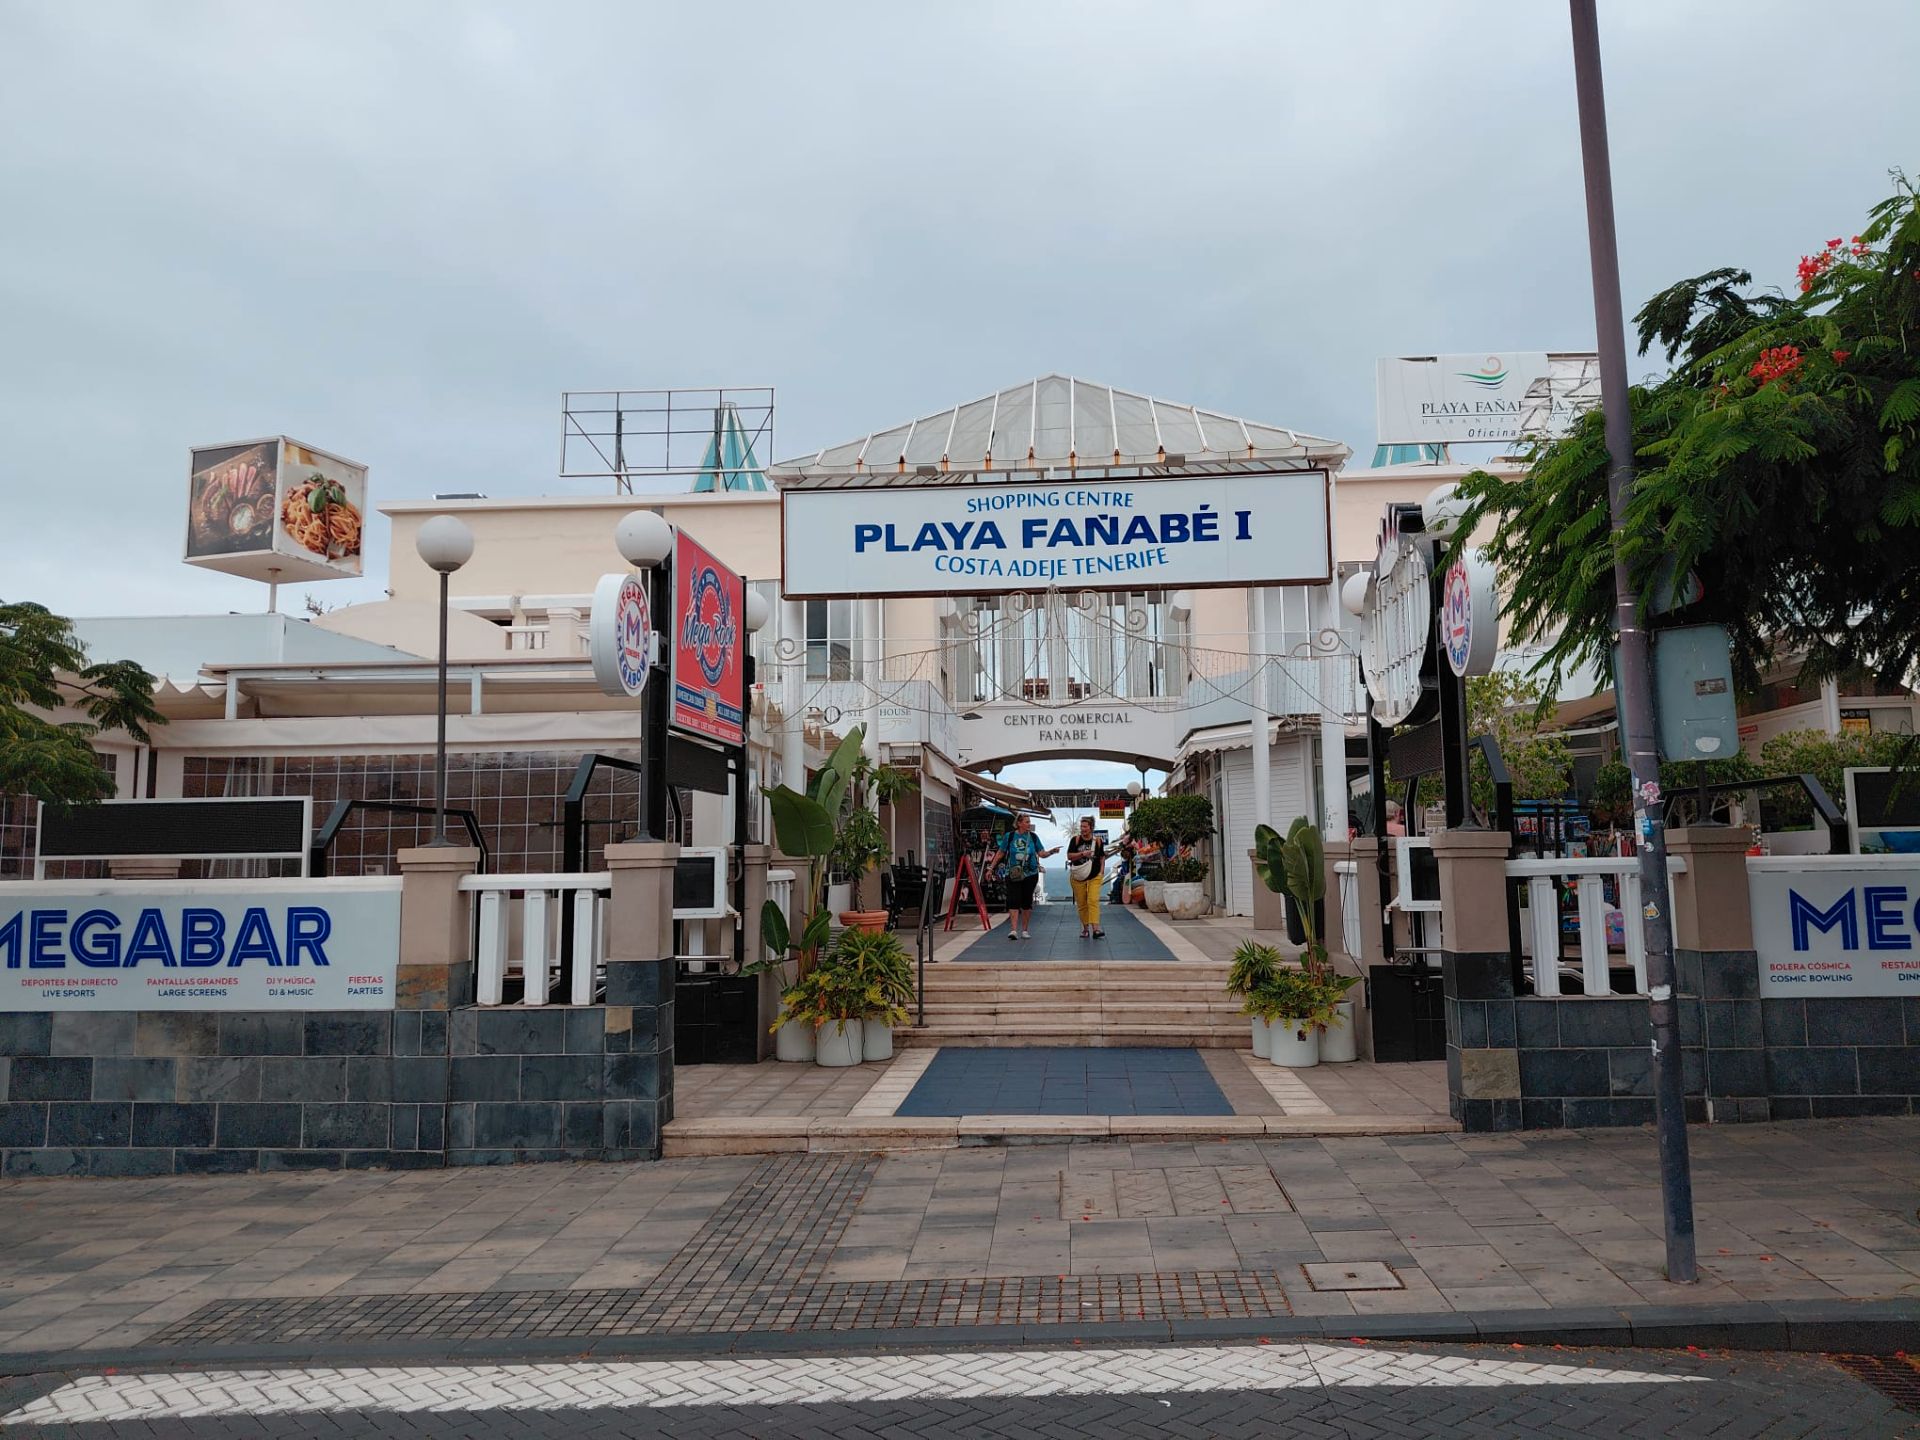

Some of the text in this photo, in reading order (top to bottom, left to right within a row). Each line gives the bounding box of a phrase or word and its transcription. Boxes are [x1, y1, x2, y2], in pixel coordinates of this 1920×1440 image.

[1421, 401, 1470, 415] PLAYA
[967, 491, 1133, 512] SHOPPING CENTRE
[855, 504, 1252, 553] PLAYA FAÑABÉ I
[934, 547, 1169, 581] COSTA ADEJE TENERIFE
[681, 612, 737, 661] Mega Rock
[880, 708, 912, 717] HOUSE
[1004, 712, 1133, 726] CENTRO COMERCIAL
[1789, 885, 1920, 951] ME
[1769, 961, 1852, 971] BOLERA CÓSMICA
[1881, 961, 1920, 969] RESTAU
[21, 978, 118, 986] DEPORTES EN DIRECTO
[147, 977, 239, 986] PANTALLAS GRANDES
[266, 977, 277, 985] DJ
[277, 977, 283, 985] Y
[348, 976, 384, 984] FIESTAS
[1770, 974, 1853, 983] COSMIC BOWLING
[42, 989, 96, 997] LIVE SPORTS
[158, 988, 227, 997] LARGE SCREENS
[268, 988, 314, 996] DJ & MUSIC
[347, 986, 384, 995] PARTIES
